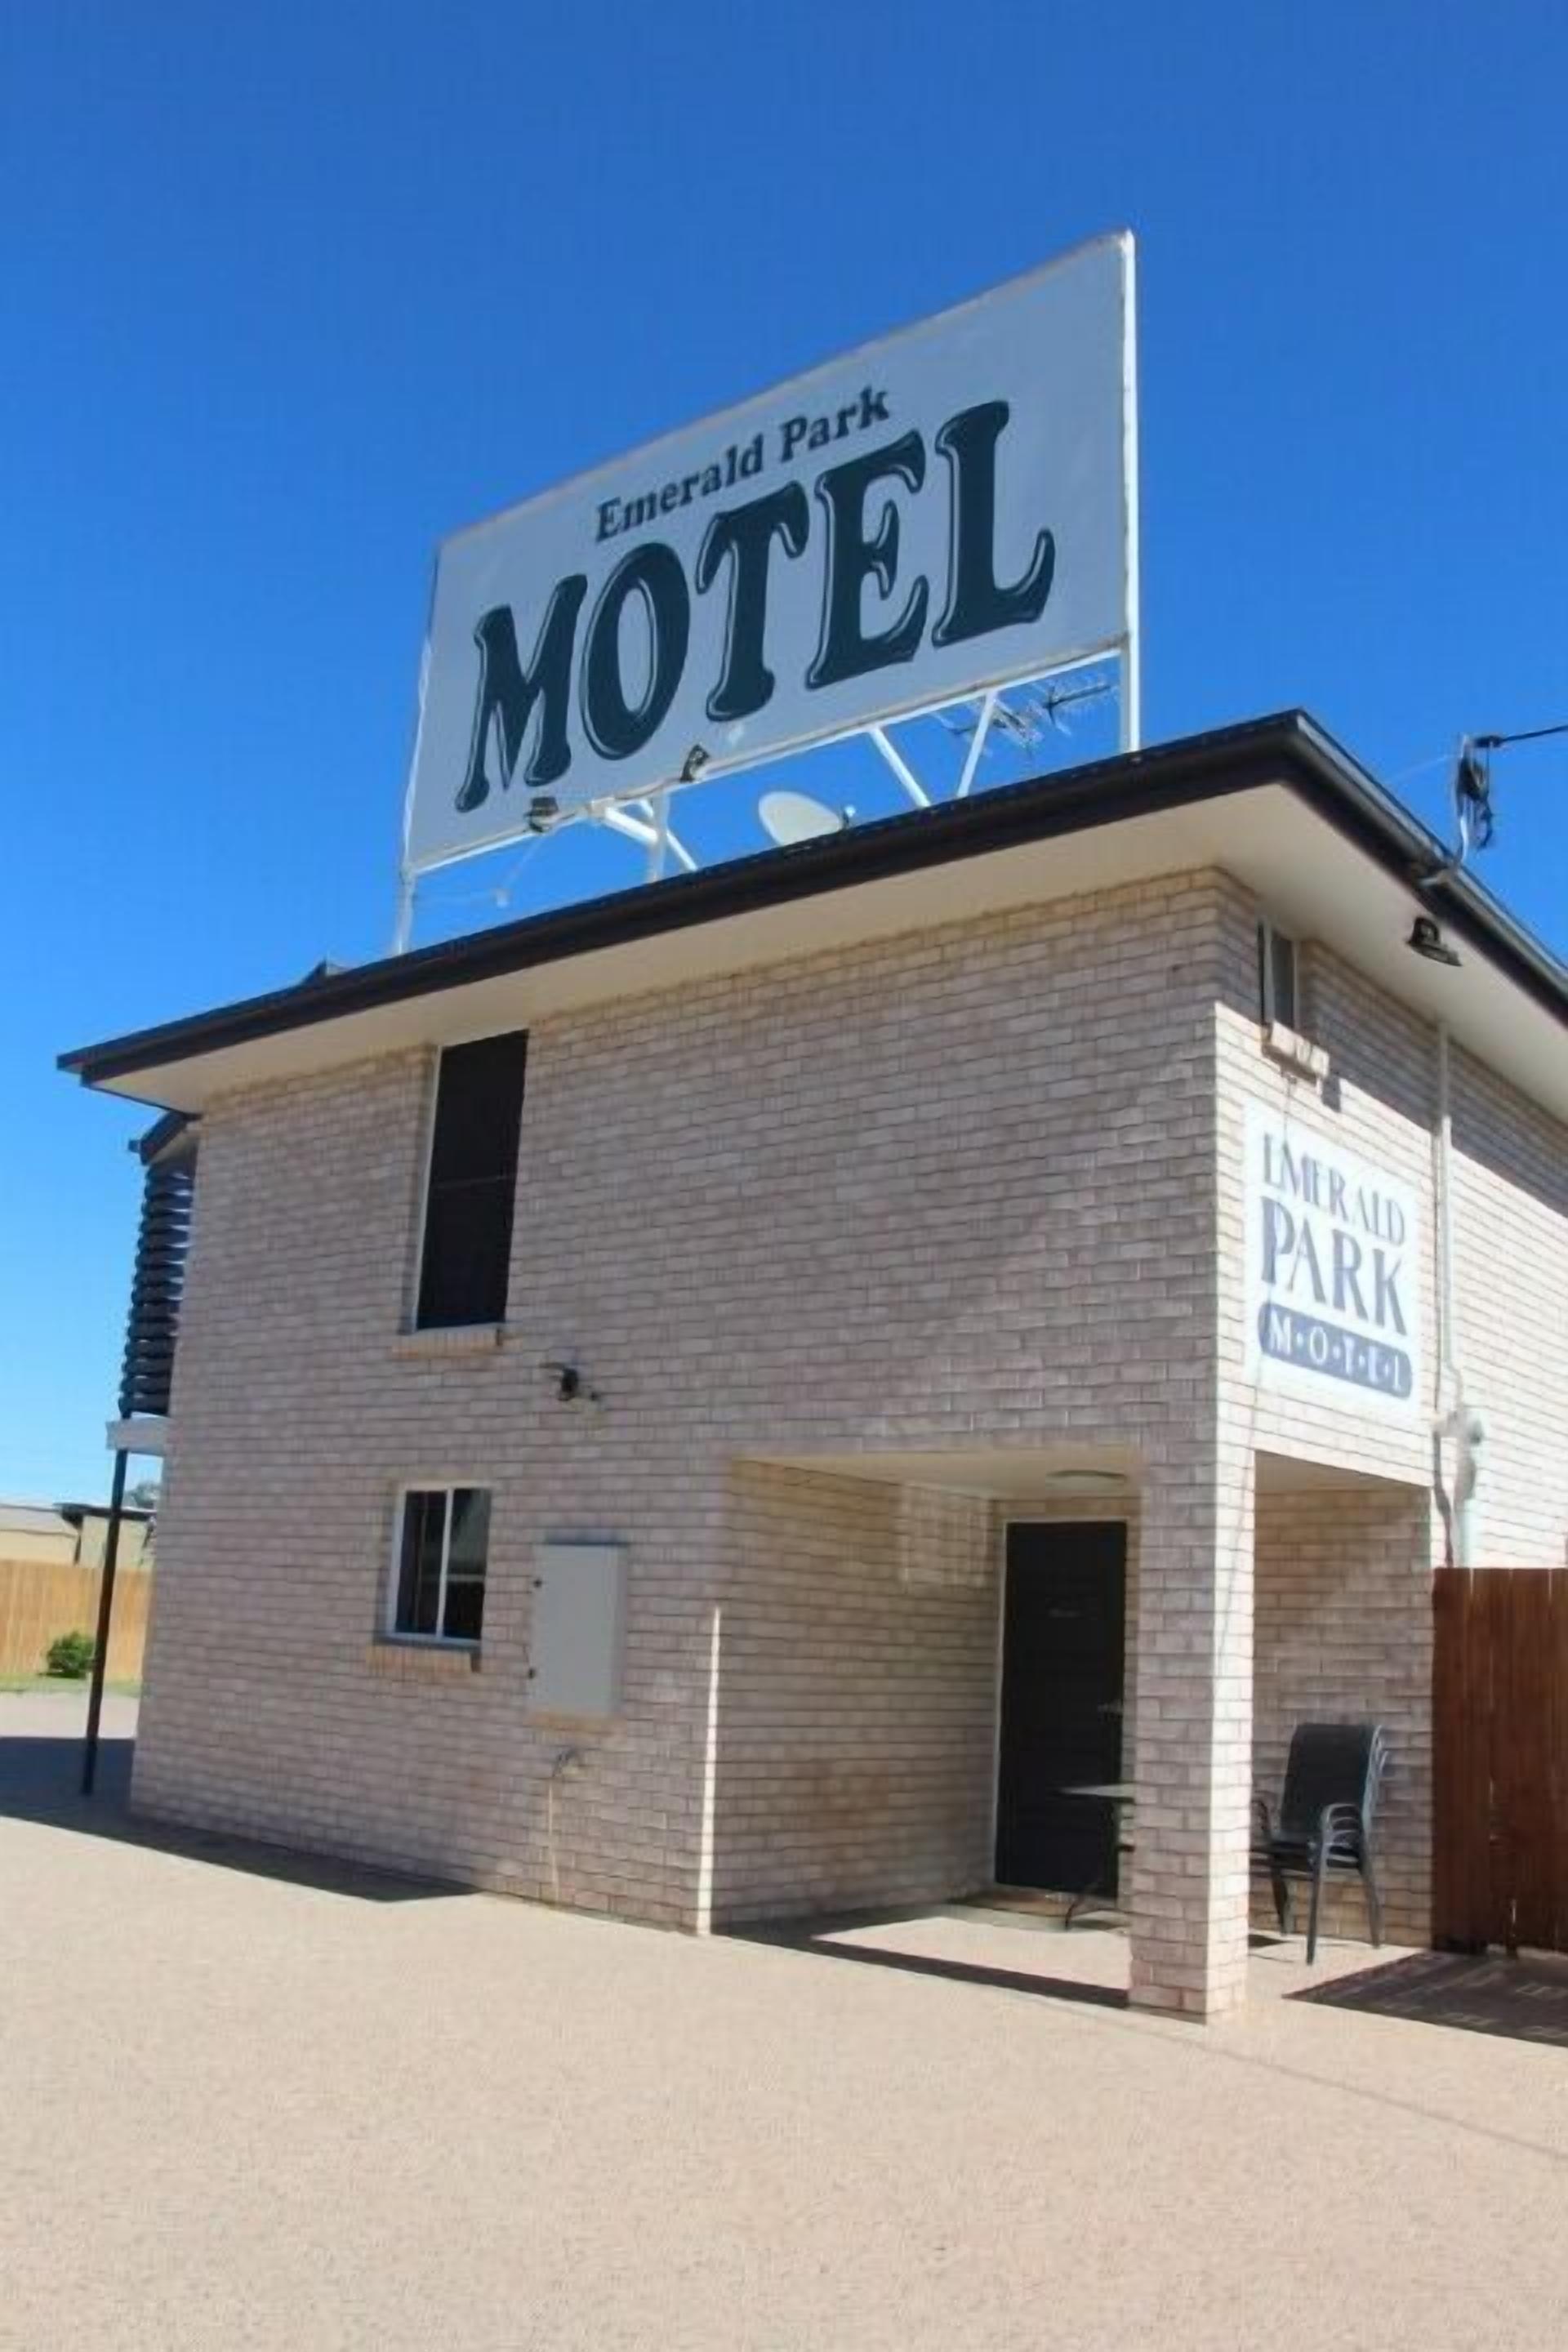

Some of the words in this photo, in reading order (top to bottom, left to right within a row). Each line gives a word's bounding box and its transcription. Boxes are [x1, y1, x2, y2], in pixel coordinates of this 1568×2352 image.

[596, 434, 764, 544] Emerald
[779, 385, 891, 464] Park
[454, 399, 1057, 813] MOTEL
[1262, 1133, 1405, 1247] EMERALD
[1261, 1196, 1408, 1337] PARK
